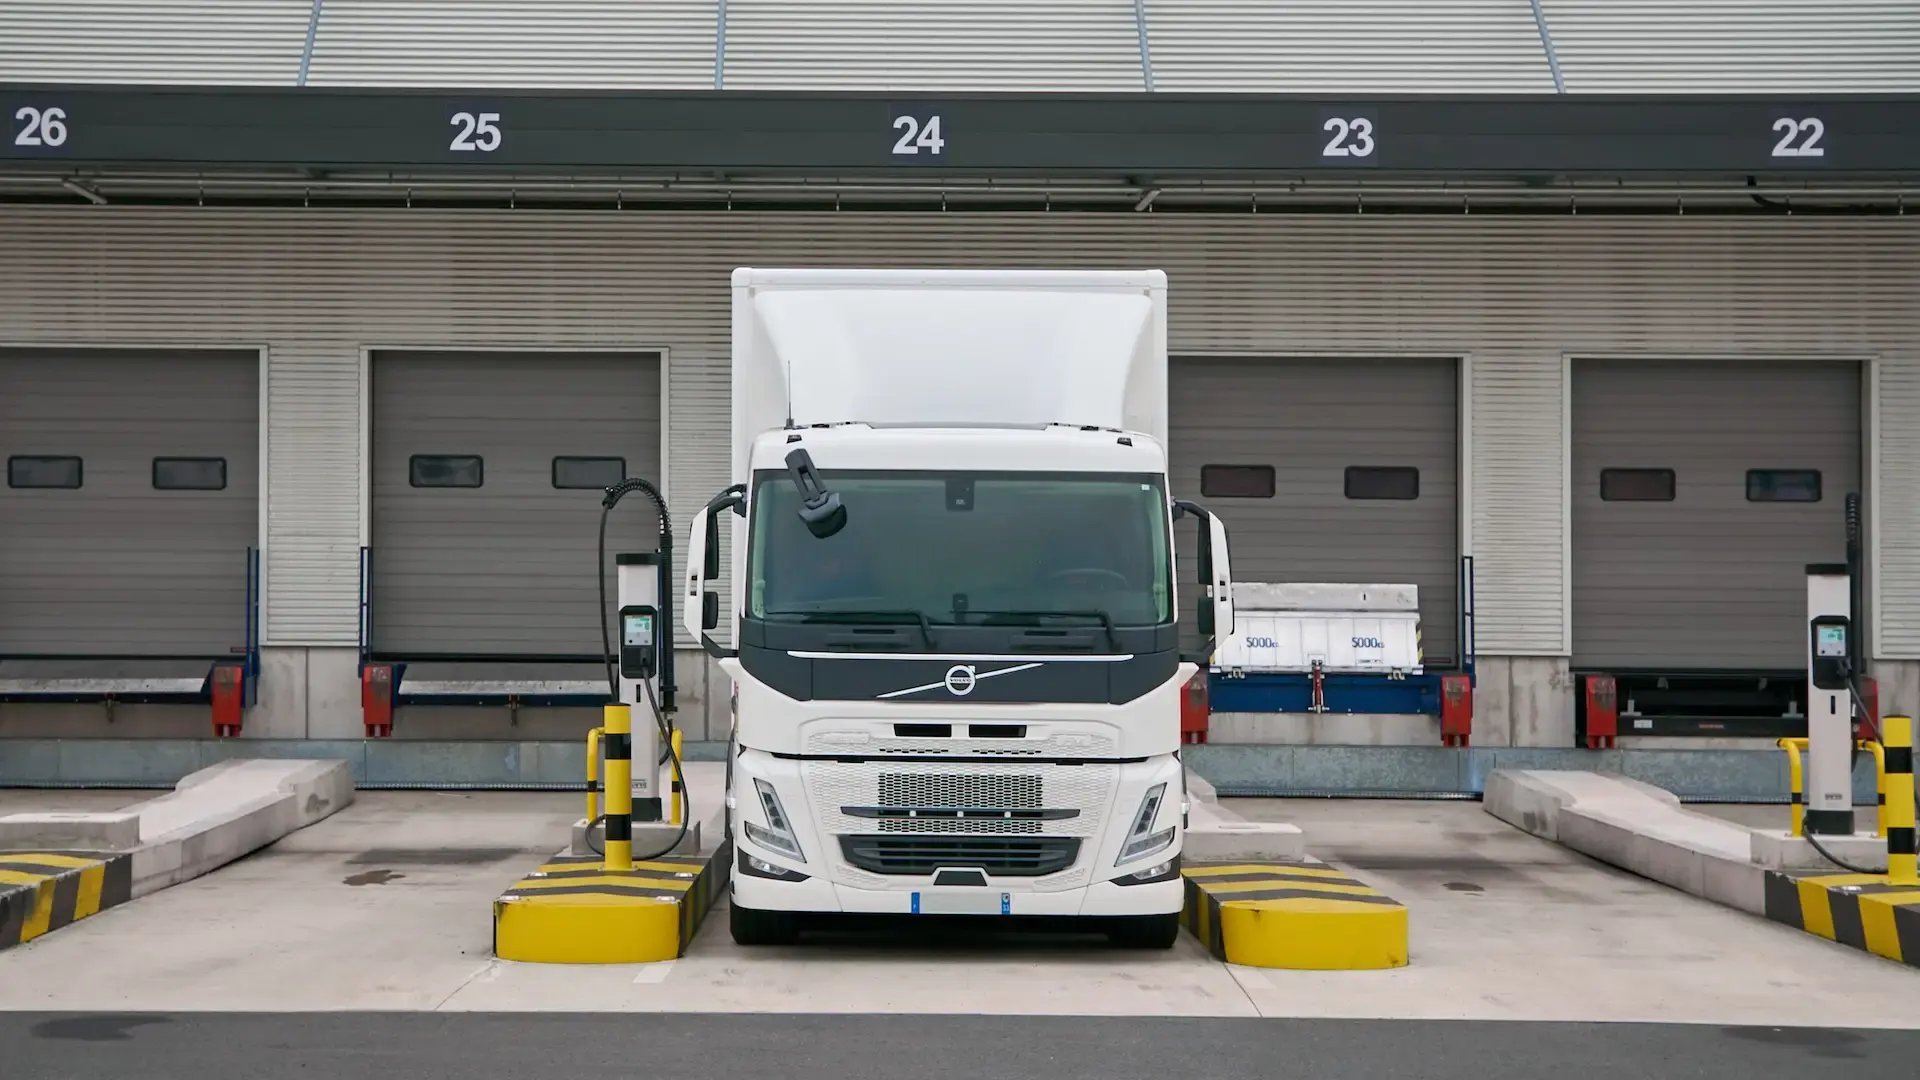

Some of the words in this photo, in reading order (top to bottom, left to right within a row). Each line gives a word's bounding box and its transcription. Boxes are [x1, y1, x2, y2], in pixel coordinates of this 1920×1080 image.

[15, 107, 66, 146] 26
[450, 113, 501, 151] 25
[893, 116, 944, 154] 24
[1323, 118, 1374, 156] 23
[1772, 118, 1824, 156] 22
